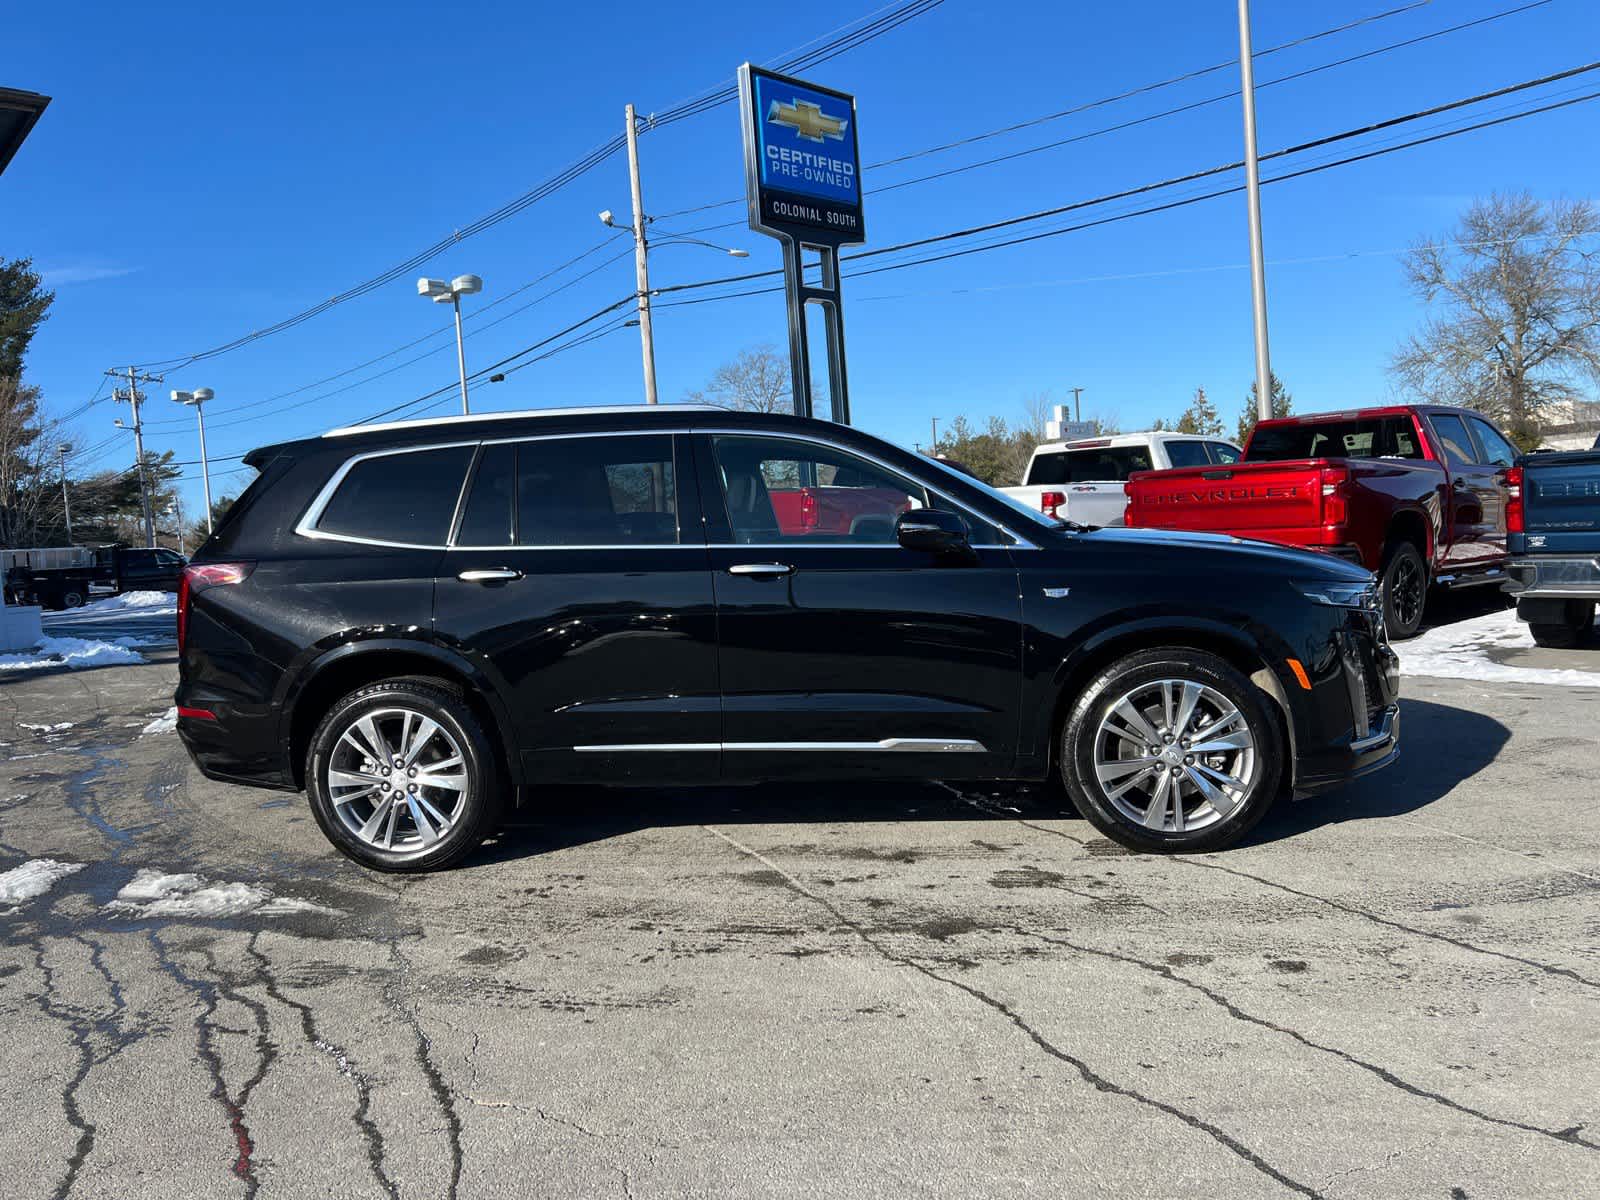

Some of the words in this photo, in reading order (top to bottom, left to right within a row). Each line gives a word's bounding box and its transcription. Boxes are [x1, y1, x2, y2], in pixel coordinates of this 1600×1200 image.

[767, 145, 854, 175] CERTIFIED
[772, 161, 851, 188] PRE-OWNED
[773, 201, 821, 221] COLONIAL
[827, 211, 856, 228] SOUTH
